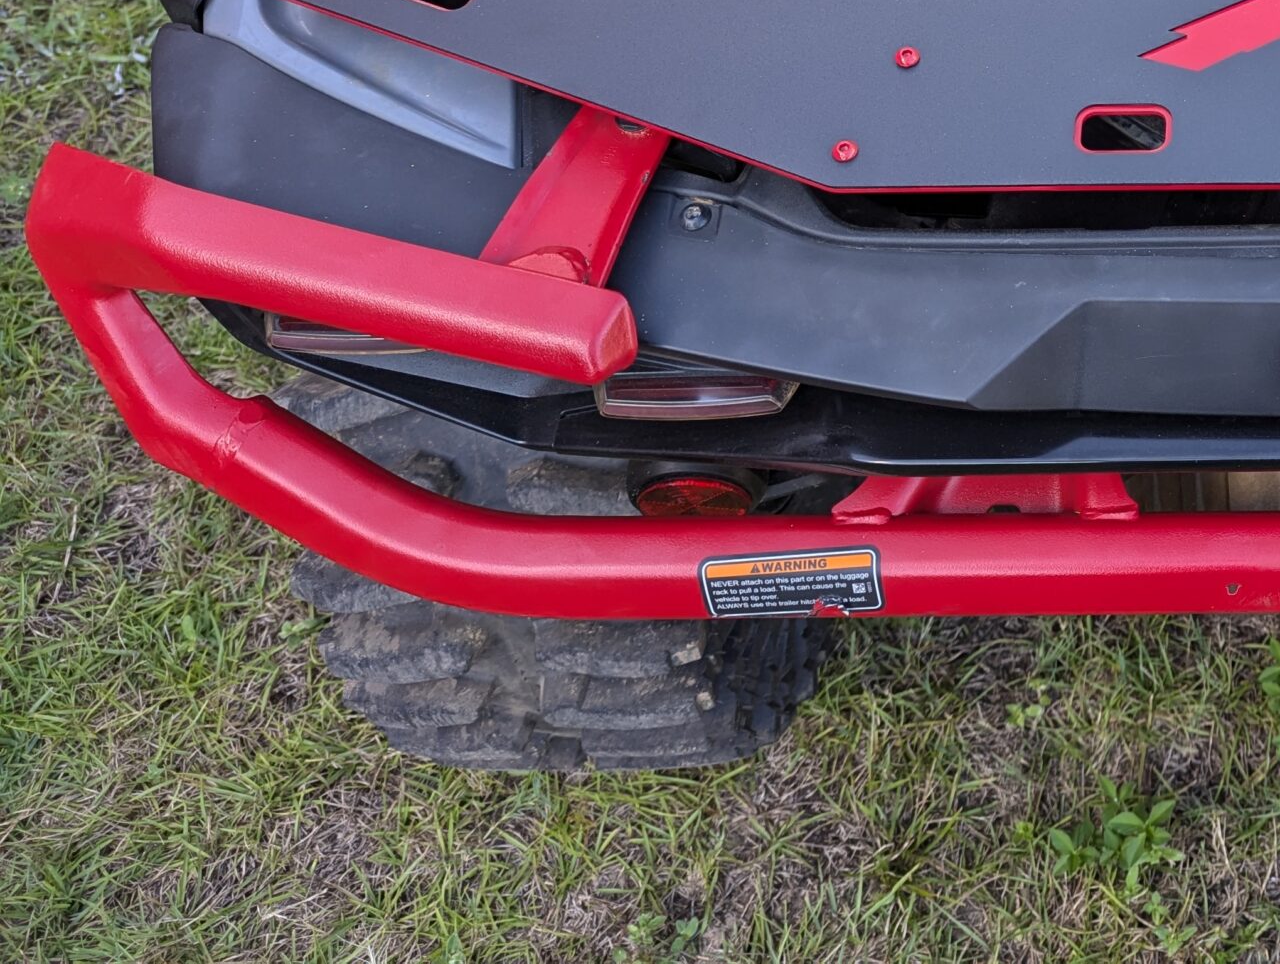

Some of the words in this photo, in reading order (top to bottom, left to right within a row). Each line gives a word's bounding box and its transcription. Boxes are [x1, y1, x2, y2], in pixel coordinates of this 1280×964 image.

[762, 558, 828, 573] WARNING
[710, 579, 740, 588] NEVER
[741, 577, 763, 587] attach
[764, 577, 775, 585] on
[775, 576, 789, 585] this
[790, 575, 805, 585] part
[815, 574, 826, 582] on
[827, 572, 839, 581] the
[840, 571, 870, 581] luggage
[712, 587, 729, 596] rack
[730, 587, 738, 595] to
[739, 586, 753, 596] pull
[760, 585, 778, 594] load.
[780, 584, 796, 592] This
[811, 582, 834, 590] cause
[834, 581, 848, 589] the
[714, 596, 741, 604] vehicle
[750, 594, 760, 603] tip
[760, 593, 780, 601] over.
[716, 601, 750, 610] ALWAYS
[764, 599, 777, 607] the
[778, 598, 799, 607] trailer
[849, 595, 868, 603] load.
